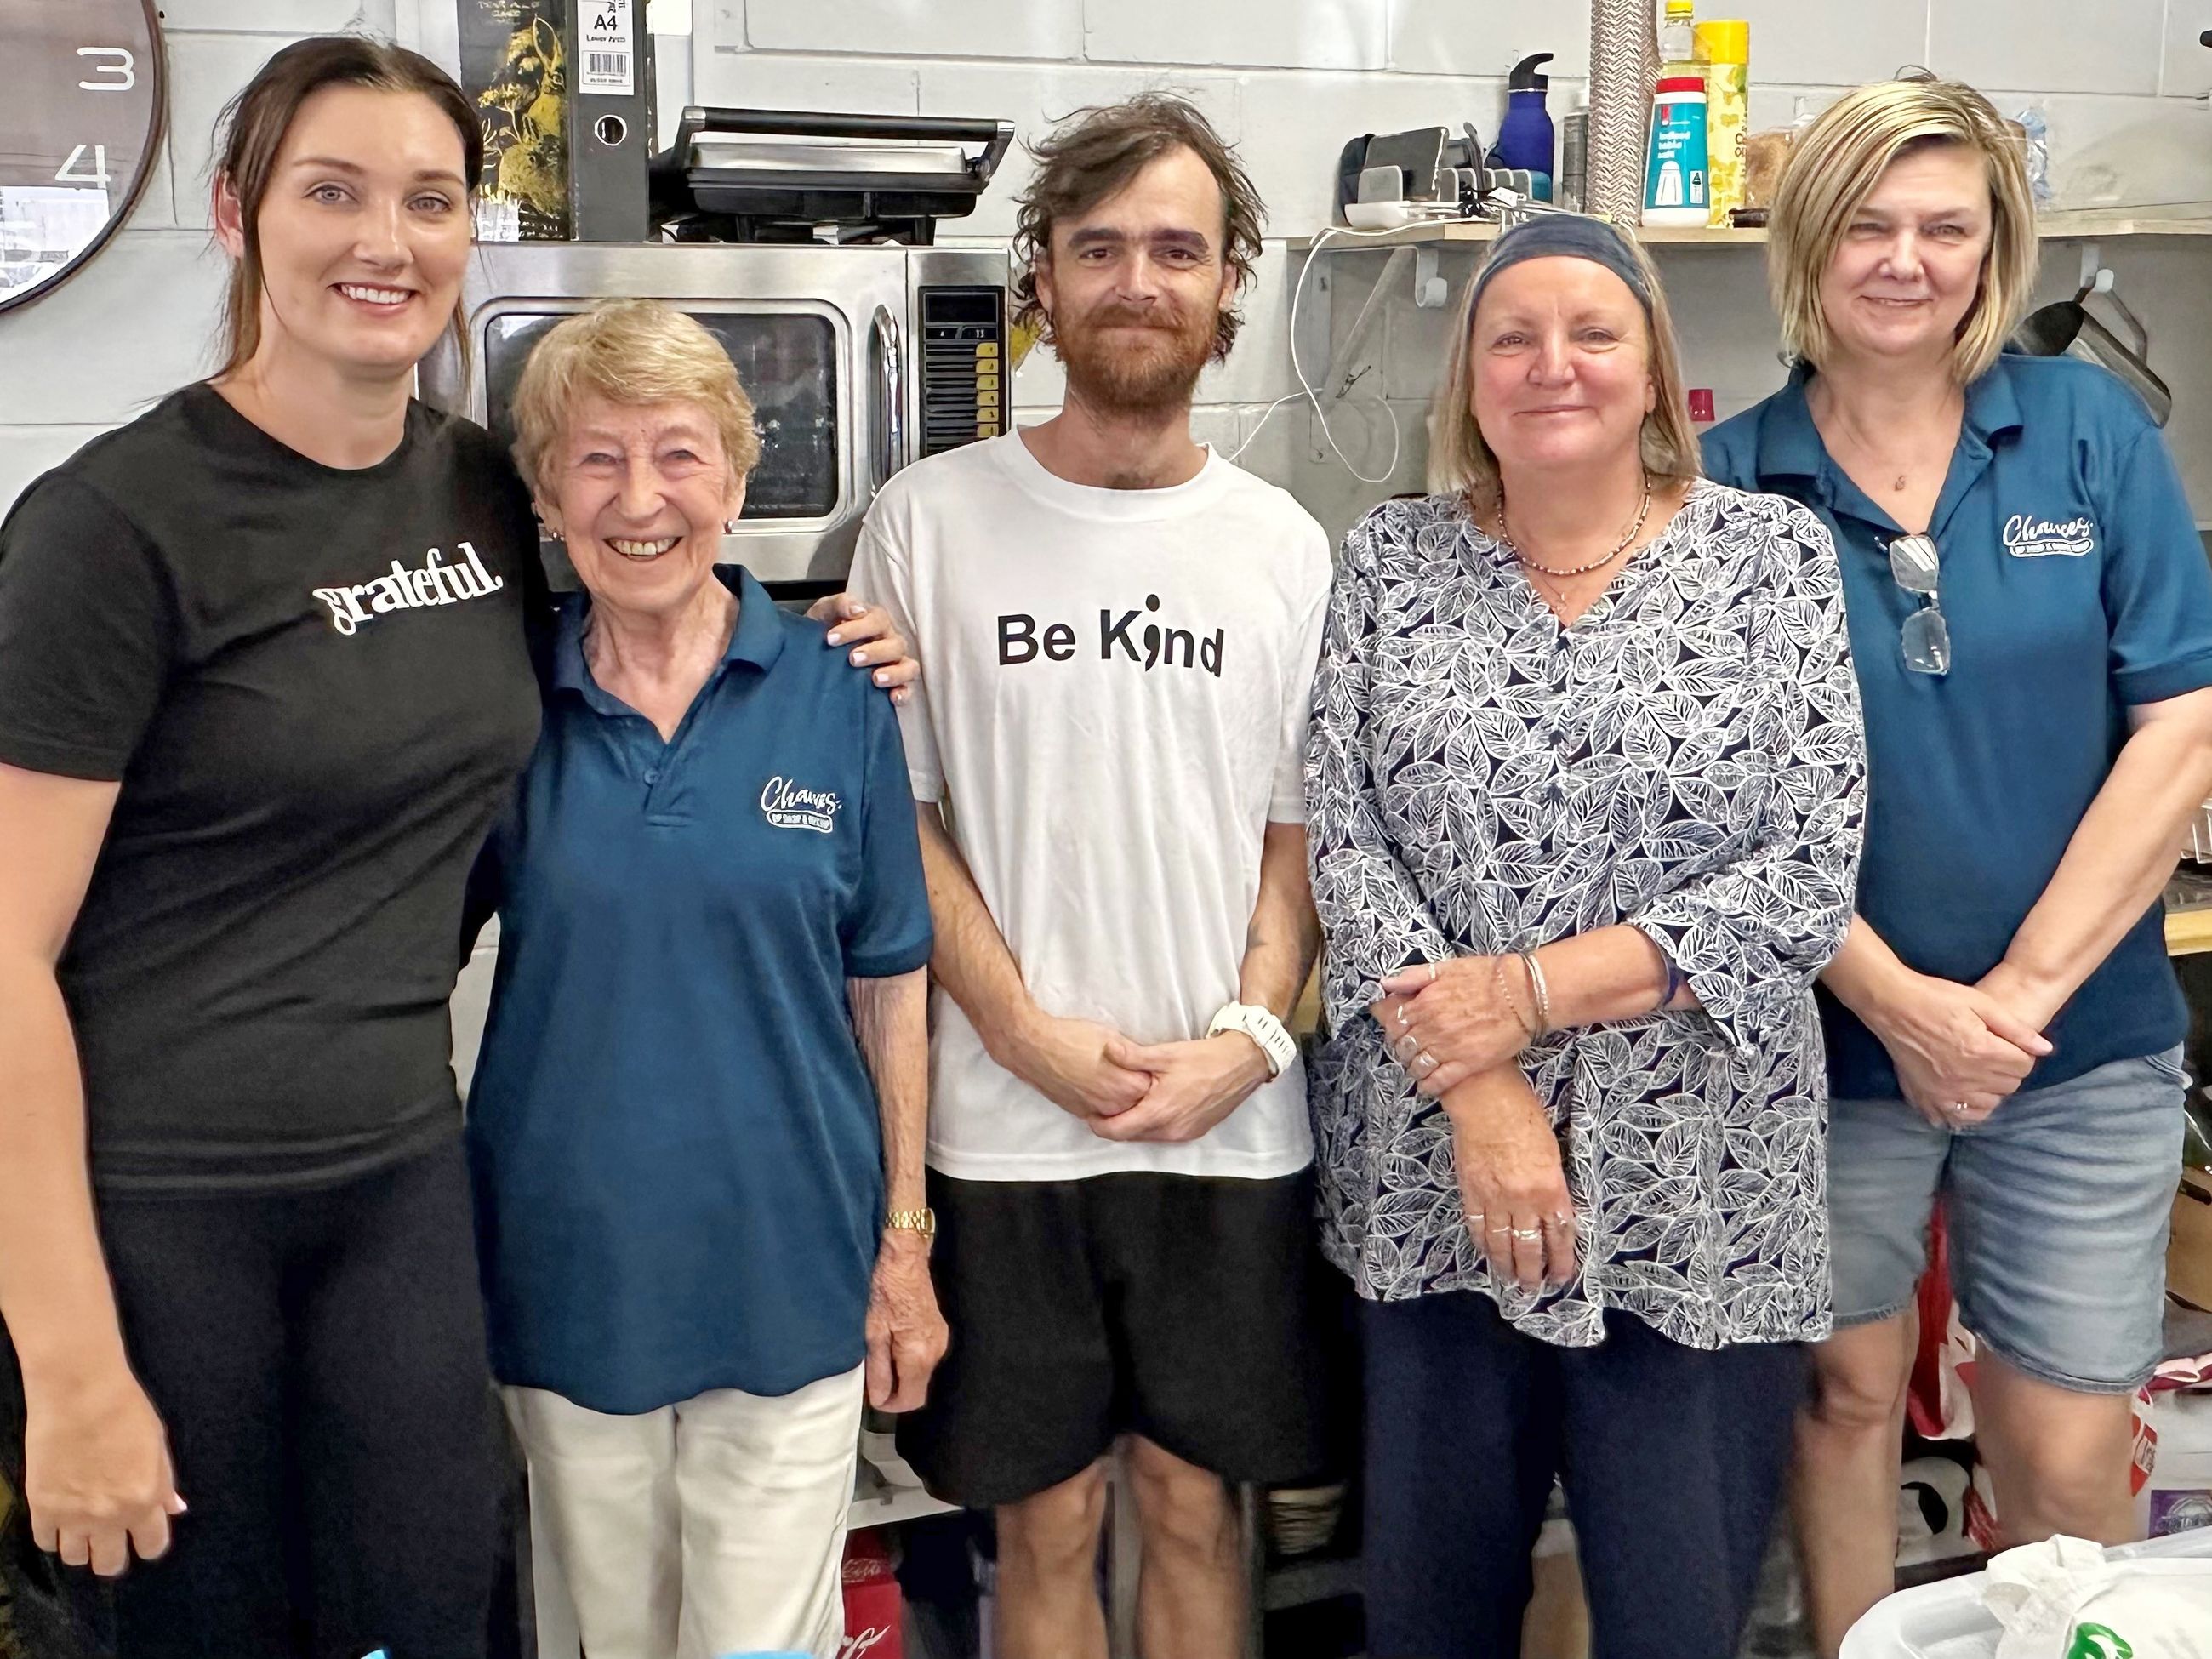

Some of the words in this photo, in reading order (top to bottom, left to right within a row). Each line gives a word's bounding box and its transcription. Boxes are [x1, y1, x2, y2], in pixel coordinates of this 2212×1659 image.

[594, 14, 618, 31] A4
[77, 47, 135, 91] 3
[54, 145, 111, 190] 4
[998, 613, 1076, 665] Be
